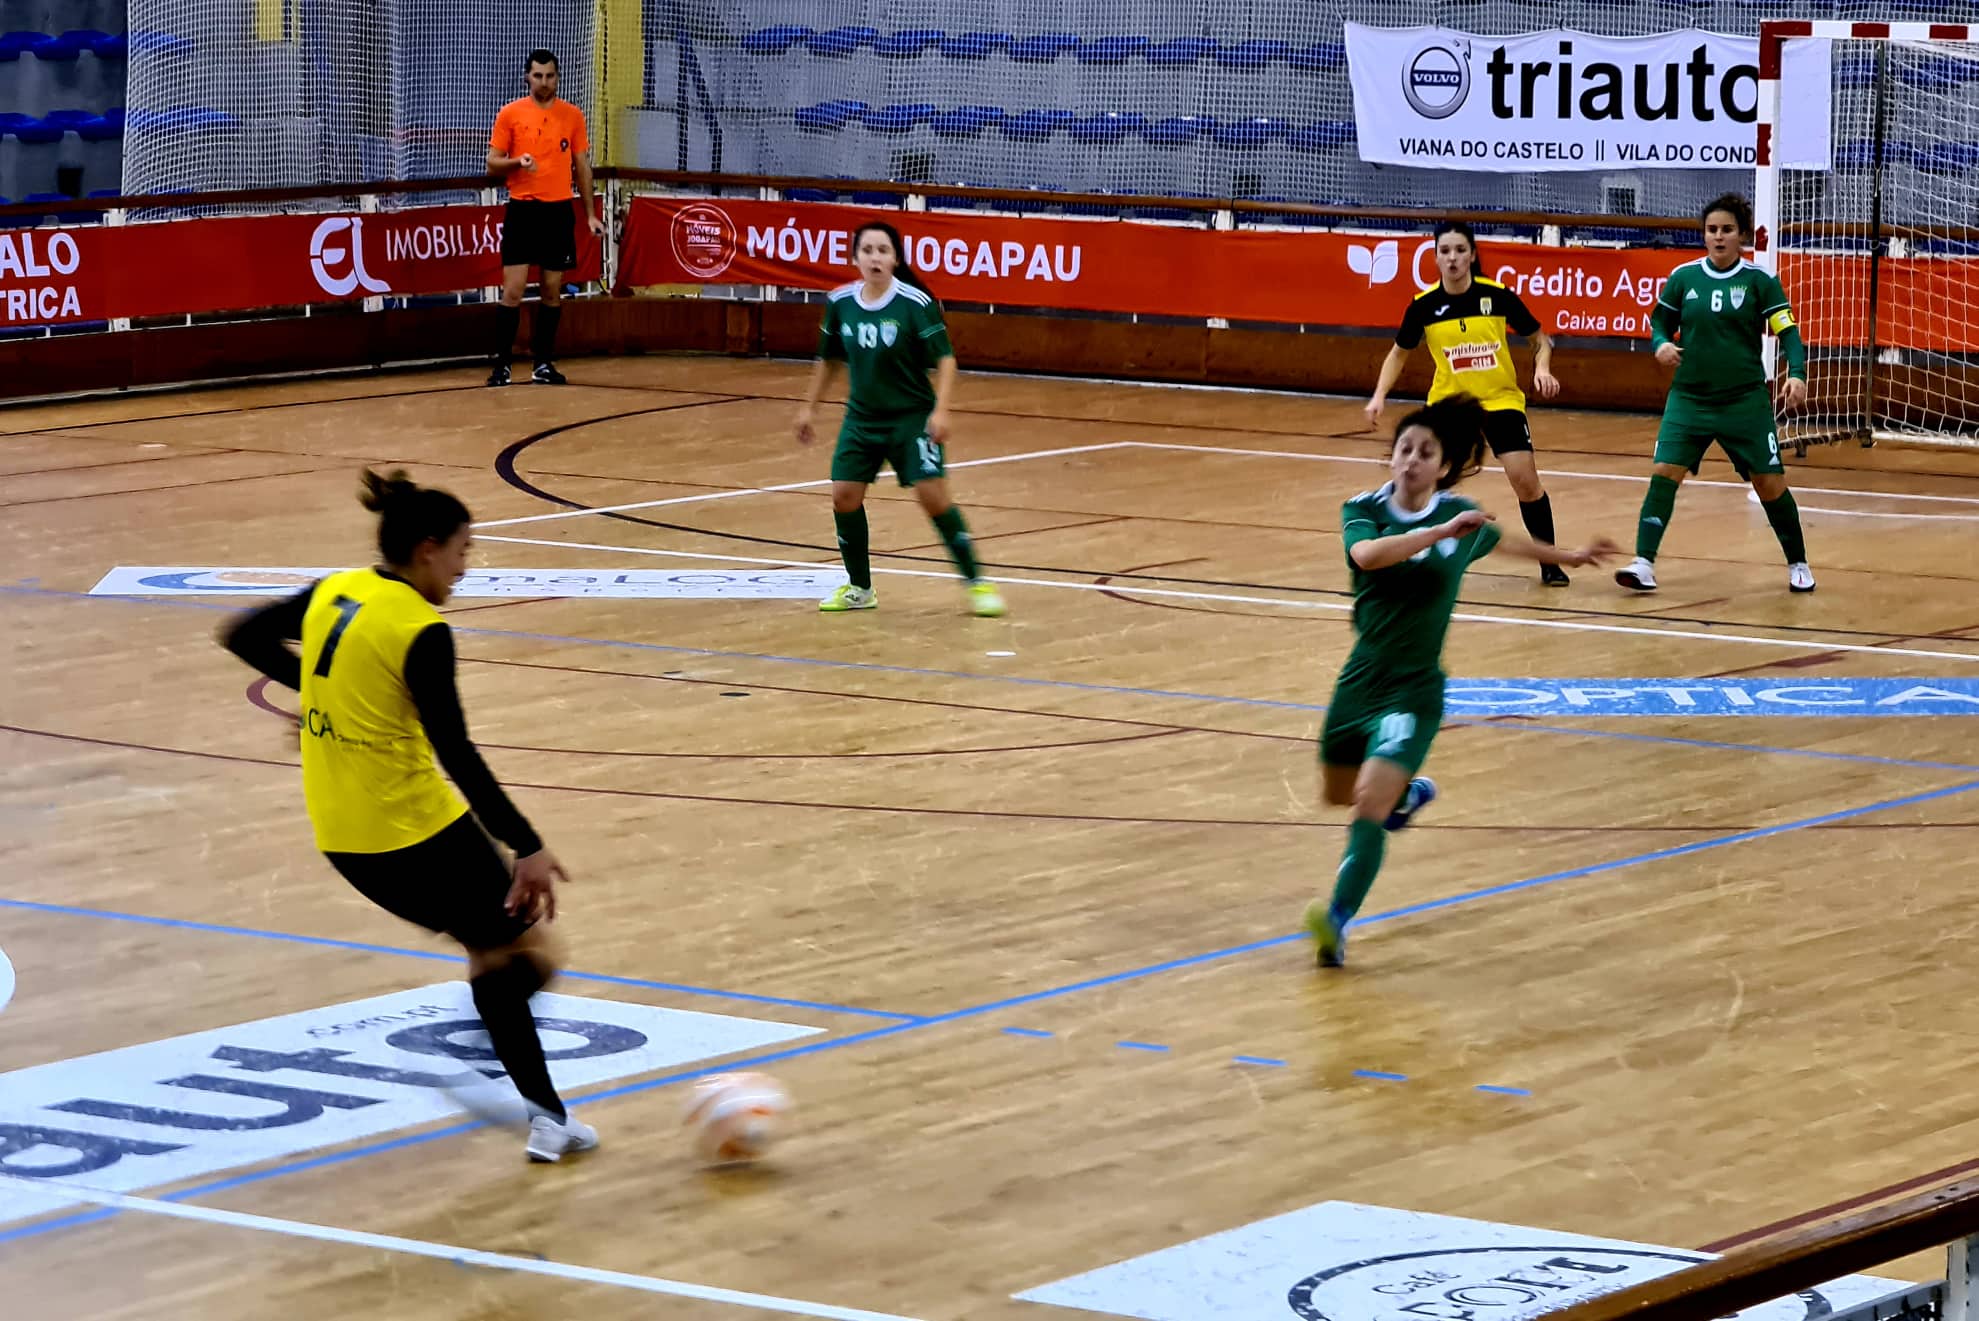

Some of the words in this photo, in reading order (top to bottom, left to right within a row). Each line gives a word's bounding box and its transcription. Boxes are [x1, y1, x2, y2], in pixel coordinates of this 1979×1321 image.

[1413, 73, 1460, 84] VOLVO
[1487, 41, 1758, 124] triauto
[1400, 138, 1456, 157] VIANA
[1461, 140, 1488, 157] DO
[1494, 142, 1584, 160] CASTELO
[1616, 143, 1660, 161] VILA
[1666, 144, 1694, 161] DO
[1700, 145, 1757, 163] COND
[746, 217, 855, 265] MÓVE
[1496, 265, 1603, 298] Crédito
[1612, 268, 1668, 306] Agr
[1711, 289, 1723, 312] 6
[1556, 310, 1607, 331] Caixa
[1613, 312, 1636, 332] do
[312, 594, 365, 678] 7
